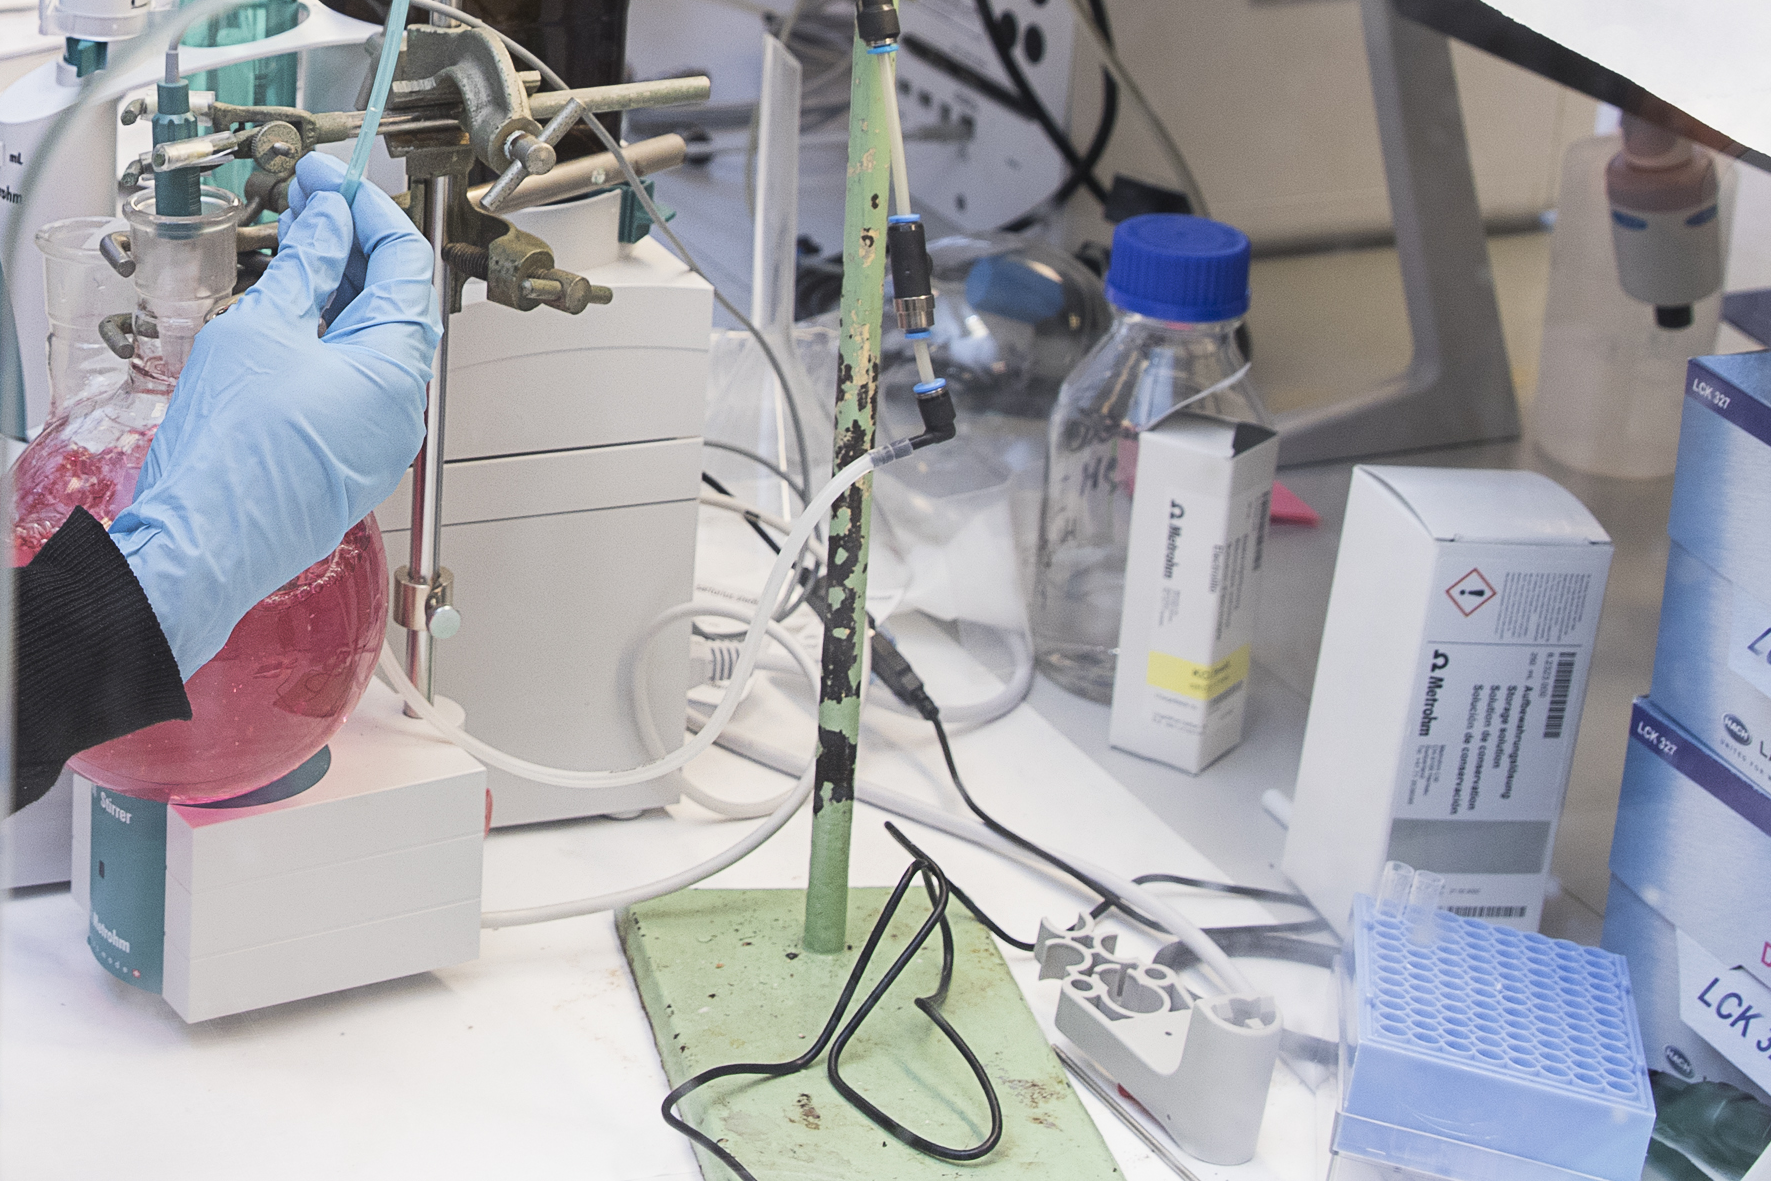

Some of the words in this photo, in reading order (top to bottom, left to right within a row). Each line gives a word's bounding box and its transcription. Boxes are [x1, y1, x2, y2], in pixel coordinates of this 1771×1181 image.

[1692, 378, 1714, 400] LCK
[1713, 391, 1731, 410] 327
[1163, 523, 1183, 579] Metrohm
[1419, 676, 1445, 737] Metrohm
[1466, 684, 1484, 730] Solución
[1484, 684, 1501, 728] Solution
[1499, 684, 1518, 726] Storage
[1463, 732, 1474, 745] de
[1480, 730, 1492, 743] de
[1492, 727, 1508, 769] solution
[1500, 685, 1534, 800] Aufbewahrungslösung
[1637, 721, 1659, 745] LCK
[1658, 736, 1678, 755] 327
[1724, 717, 1750, 740] HACH
[1450, 746, 1469, 815] conservación
[1467, 744, 1487, 811] conservation
[100, 792, 132, 824] Stirrer
[93, 911, 130, 953] Metrohm
[1697, 977, 1764, 1038] LCK
